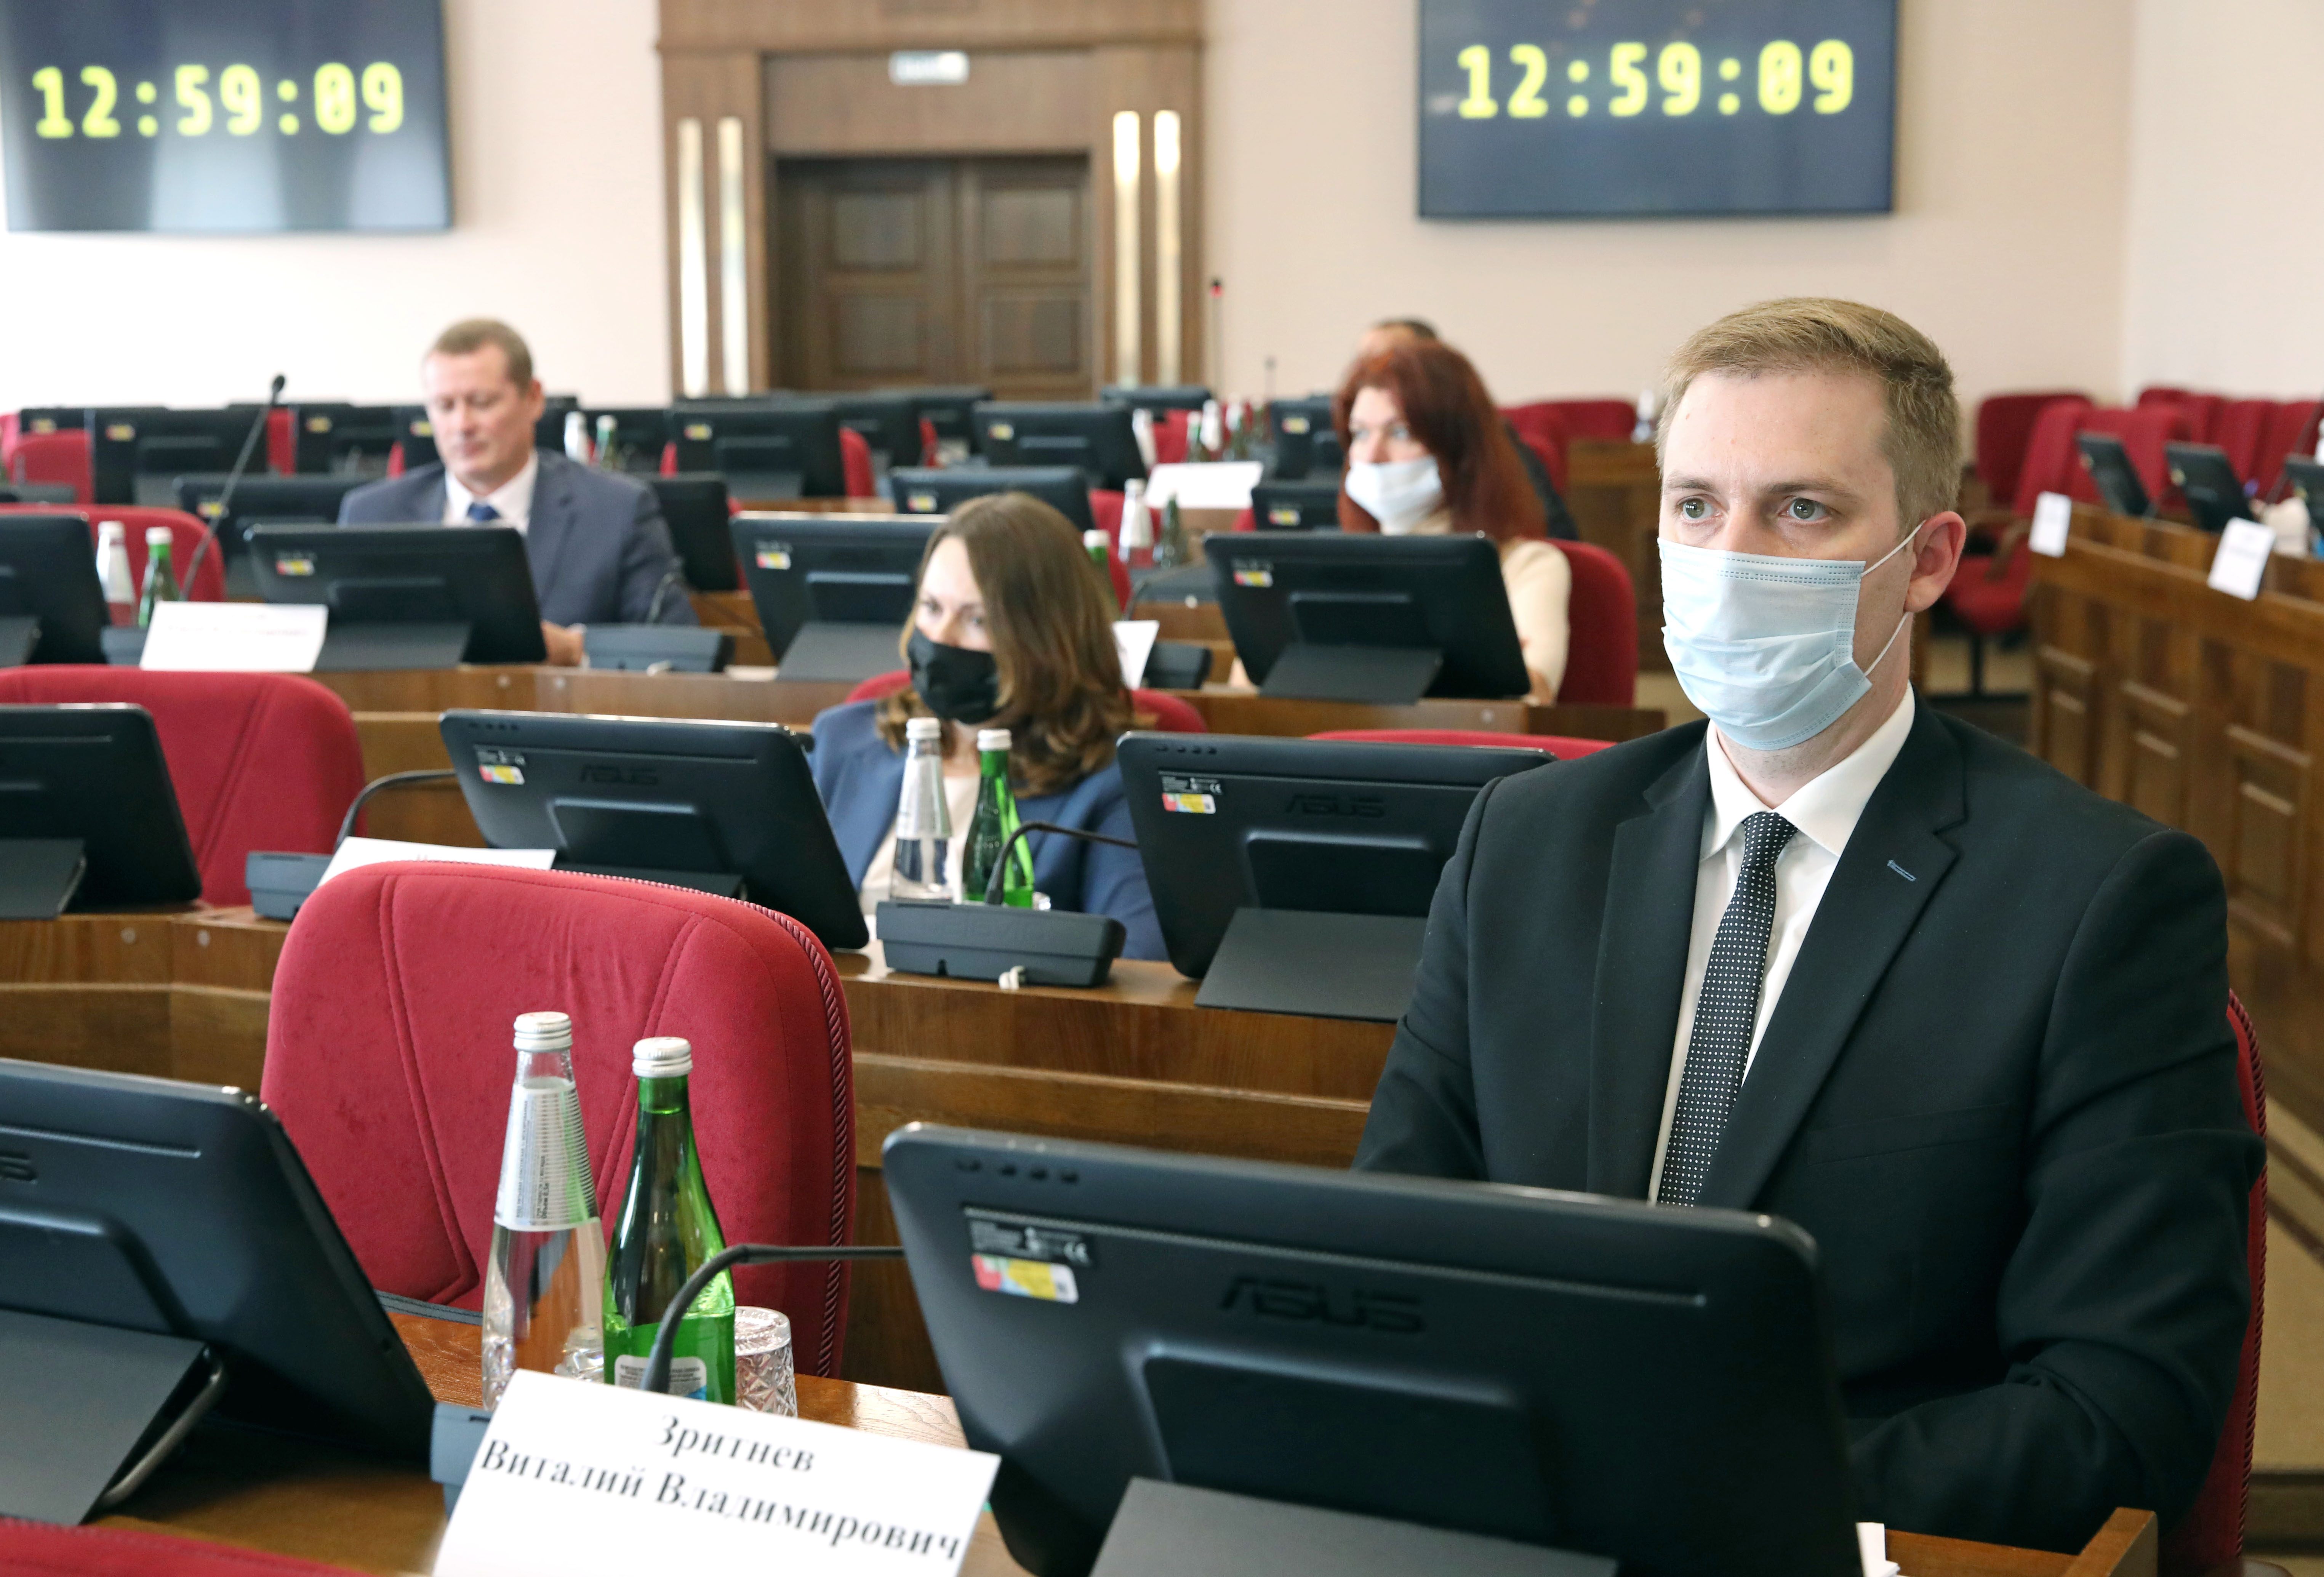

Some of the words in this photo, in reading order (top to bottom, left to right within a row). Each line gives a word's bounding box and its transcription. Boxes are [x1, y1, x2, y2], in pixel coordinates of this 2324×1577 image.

[32, 62, 404, 138] 12:59:09
[1458, 40, 1854, 119] 12:59:09
[1286, 794, 1384, 818] ASUS
[1220, 1275, 1426, 1334] ASUS
[653, 1414, 814, 1472] Зритнев
[481, 1439, 646, 1497] Виталий
[655, 1474, 961, 1560] Владимирович
